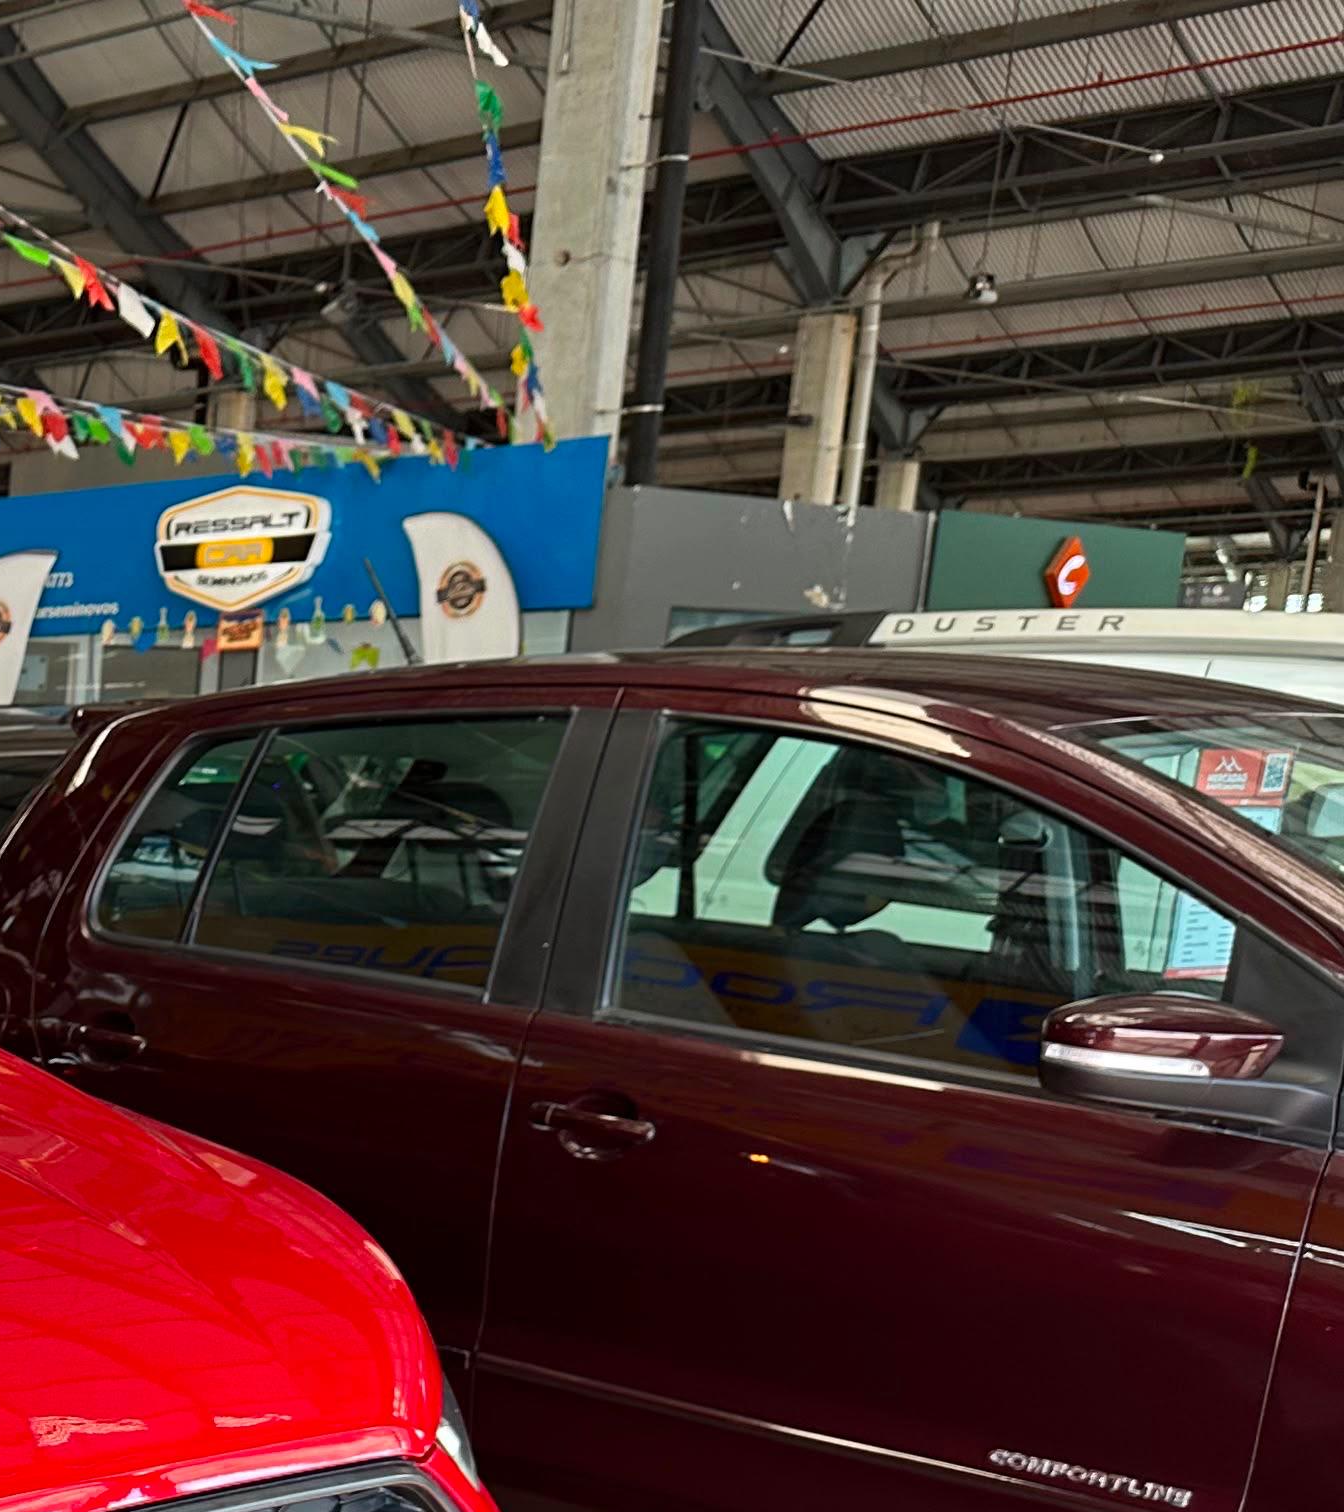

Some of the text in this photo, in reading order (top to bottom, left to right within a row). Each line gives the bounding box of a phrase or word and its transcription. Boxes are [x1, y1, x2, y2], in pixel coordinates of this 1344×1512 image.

[174, 511, 301, 536] RESSALT
[205, 541, 262, 563] CAR
[892, 614, 1125, 635] DUSTER
[989, 1448, 1194, 1509] COMFORTLINE
